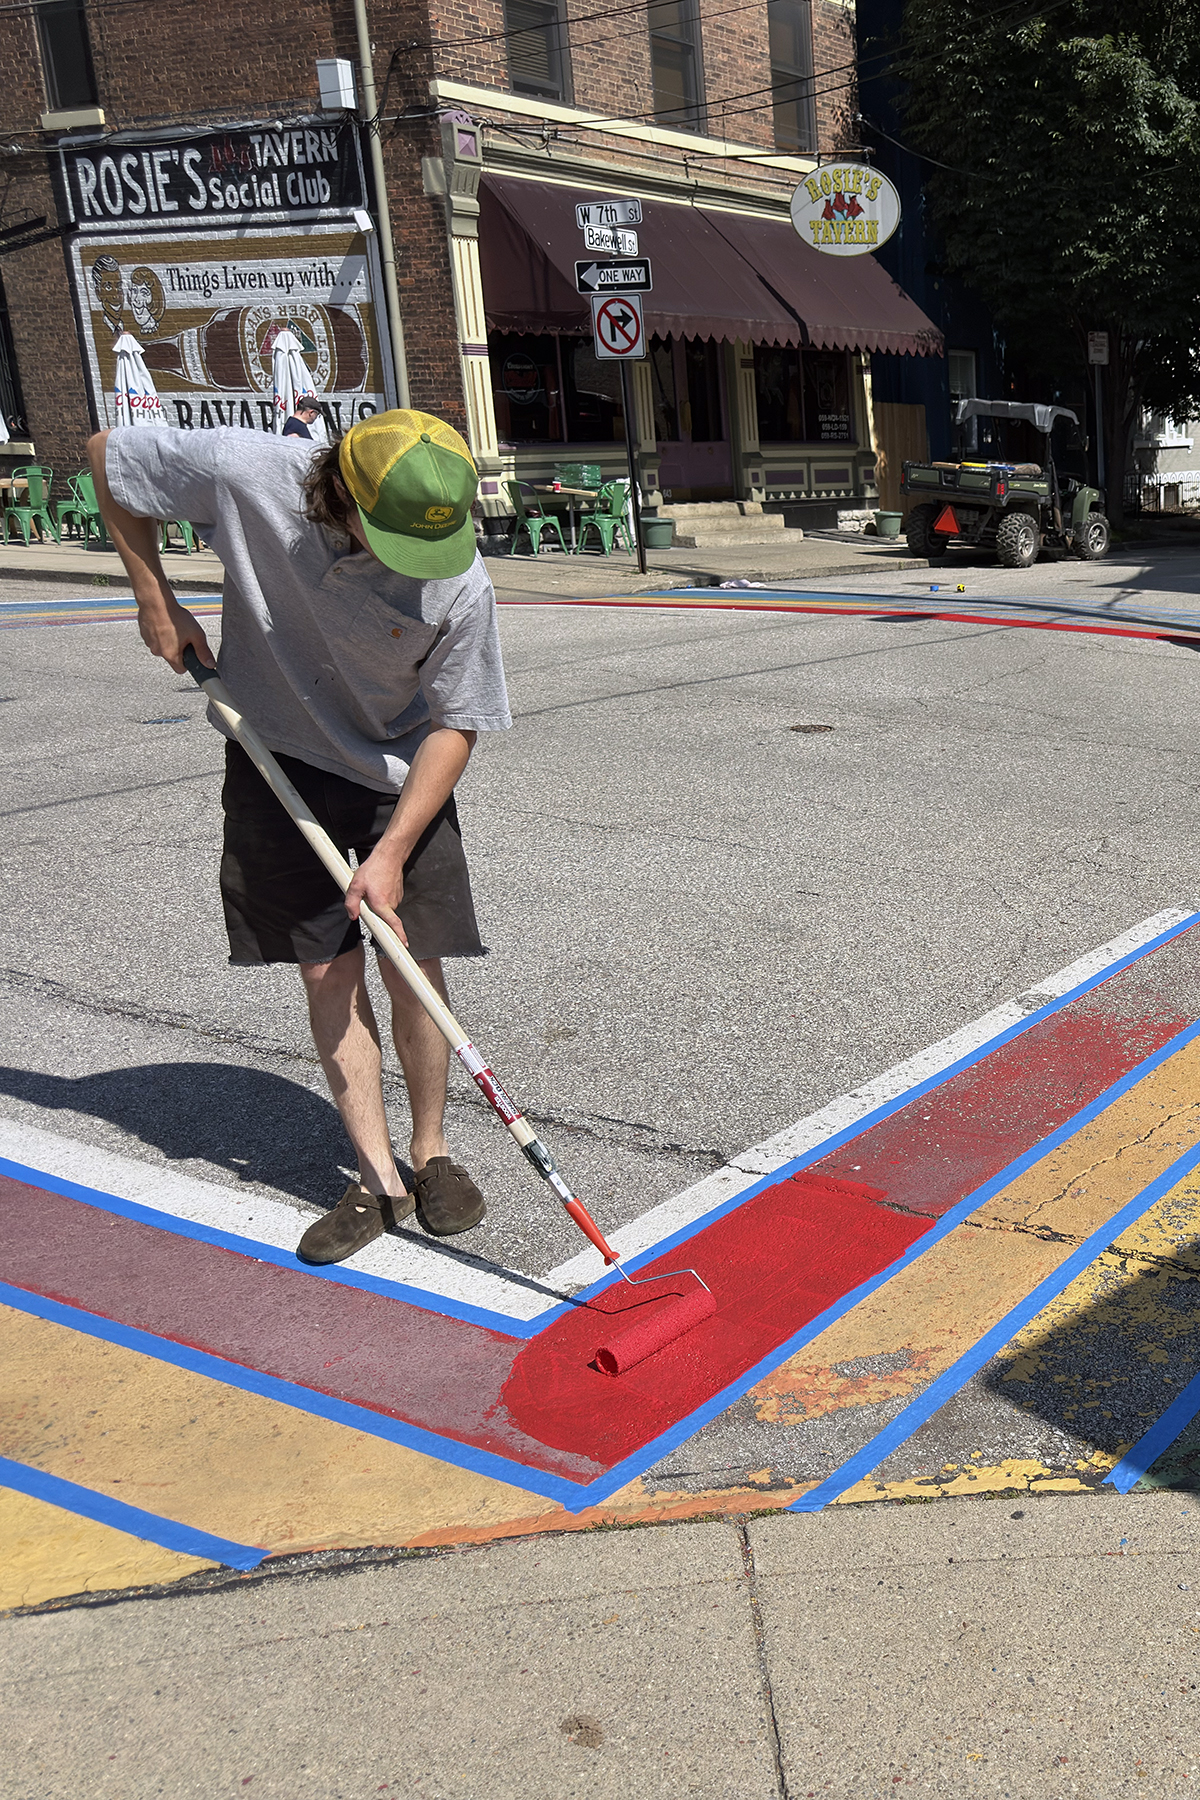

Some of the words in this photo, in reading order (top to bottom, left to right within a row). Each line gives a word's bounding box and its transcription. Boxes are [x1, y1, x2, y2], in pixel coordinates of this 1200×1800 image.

[76, 148, 208, 216] ROSIE'S
[249, 130, 339, 168] TAVERN
[209, 172, 282, 209] Social
[286, 170, 331, 206] Club
[804, 168, 883, 204] ROSIE'S
[580, 206, 590, 224] W
[596, 205, 618, 224] 7th
[628, 208, 639, 221] St
[588, 228, 627, 251] Bakewell
[628, 239, 636, 252] St
[809, 220, 880, 244] TAVERN
[166, 266, 220, 298] Things
[222, 266, 269, 289] Liven
[272, 272, 295, 294] up
[599, 269, 620, 283] ONE
[622, 268, 643, 282] WAY
[276, 304, 320, 324] BEER
[246, 305, 274, 390] AVARIAN'S
[410, 522, 434, 531] JOHN
